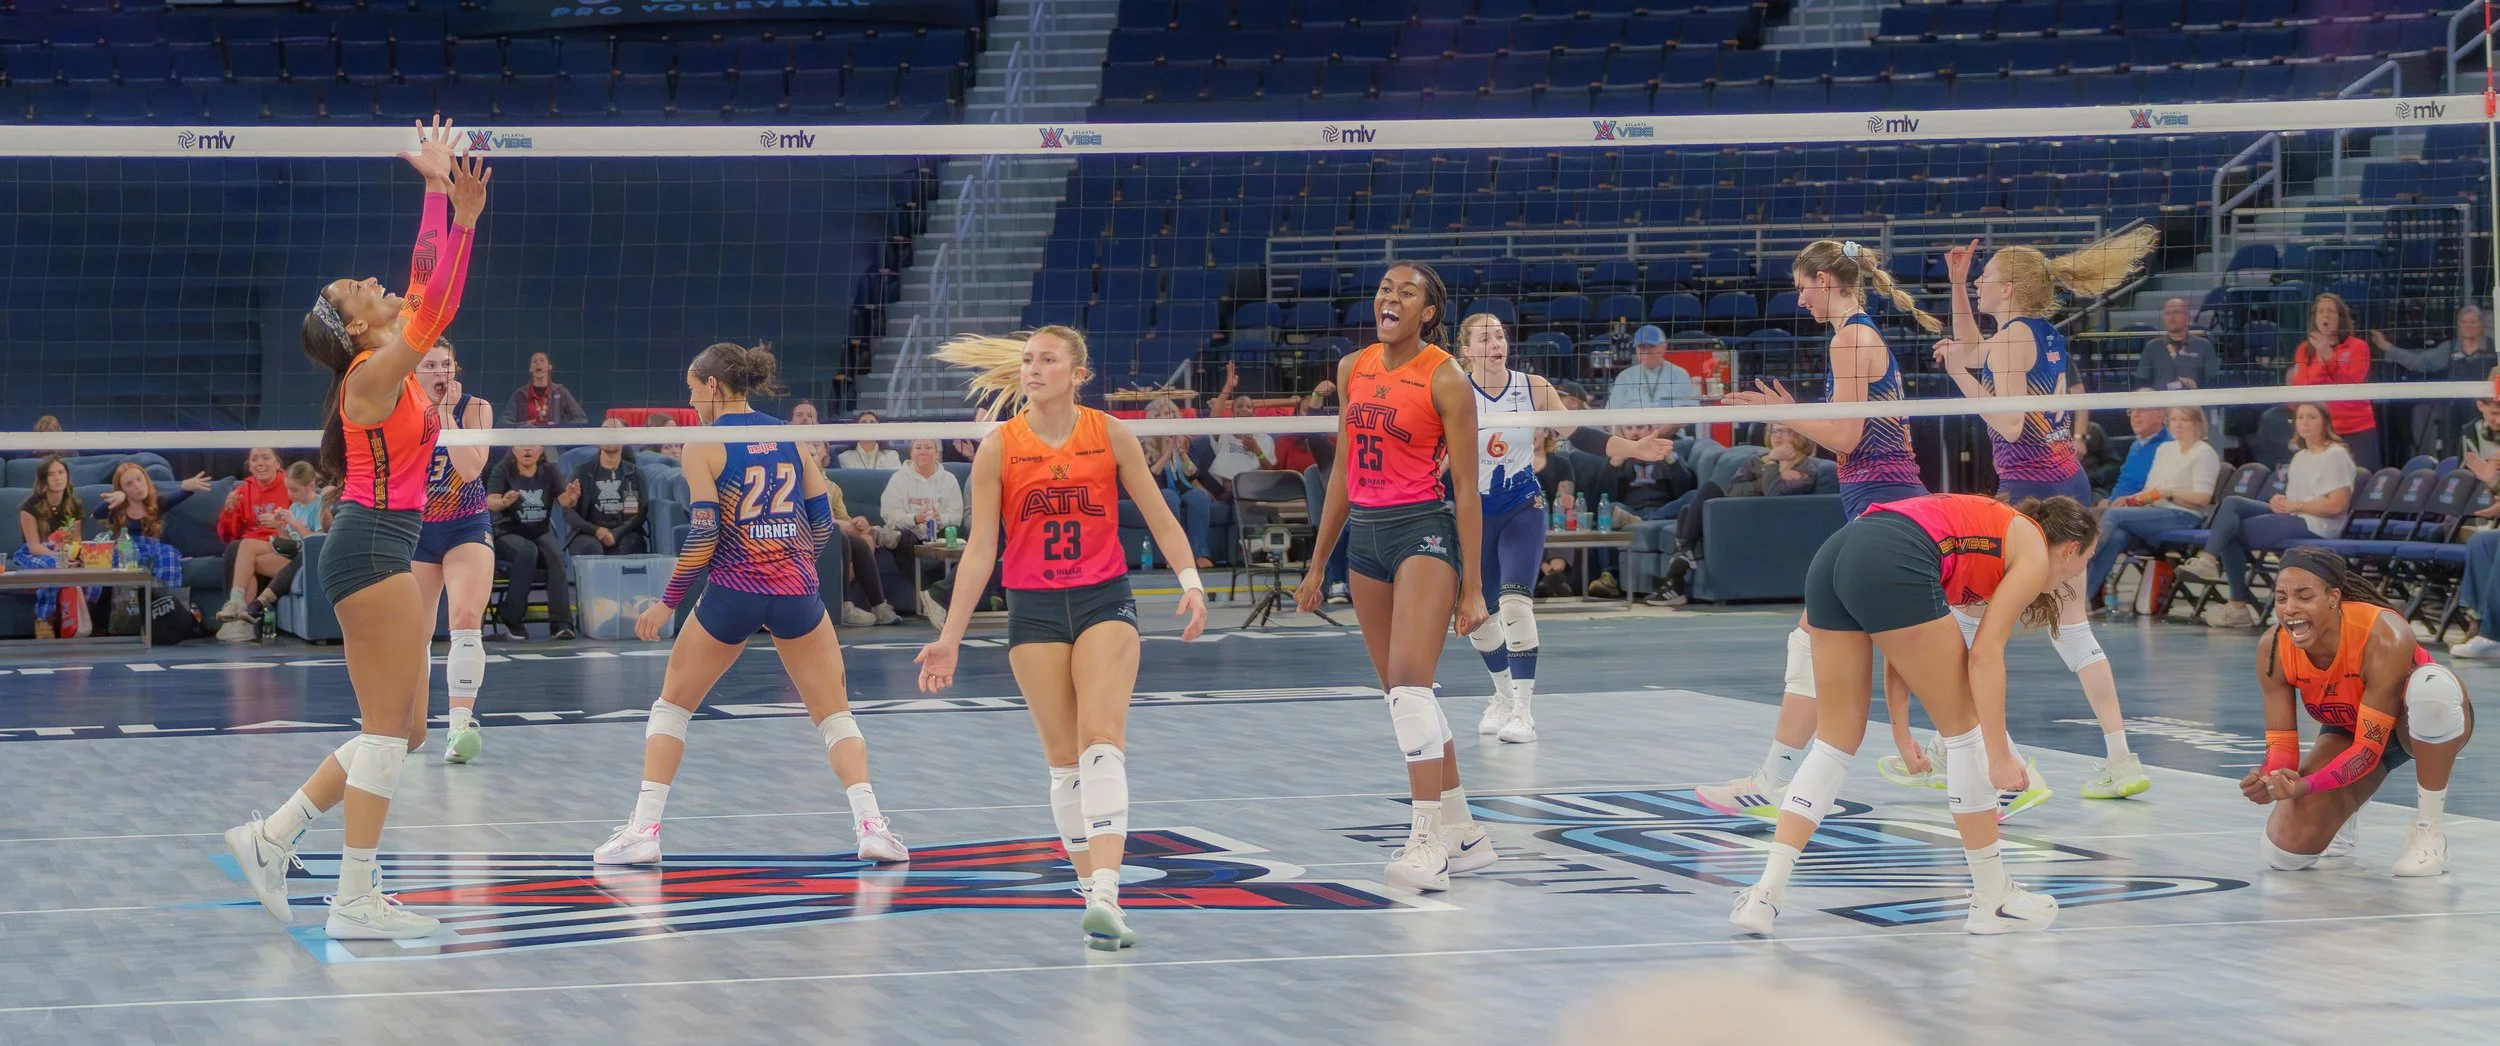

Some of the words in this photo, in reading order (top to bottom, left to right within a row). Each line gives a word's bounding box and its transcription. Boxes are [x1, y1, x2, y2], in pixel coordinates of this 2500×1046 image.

[550, 7, 622, 17] PRO
[2413, 101, 2446, 119] mlv
[1616, 126, 1654, 138] VIBE
[1886, 114, 1920, 132] mlv
[199, 130, 235, 149] mlv
[780, 130, 816, 148] mlv
[1063, 134, 1102, 146] VIBE
[1342, 124, 1376, 142] mlv
[492, 137, 532, 148] VIBE
[747, 441, 778, 455] meijer
[1356, 433, 1383, 472] 25
[1487, 431, 1509, 458] 6
[740, 462, 797, 520] 22
[1021, 485, 1106, 522] ATL
[692, 517, 716, 526] RISE
[748, 523, 798, 539] TURNER
[1043, 520, 1082, 561] 23
[152, 600, 176, 620] FUN
[2330, 745, 2378, 785] VIBE
